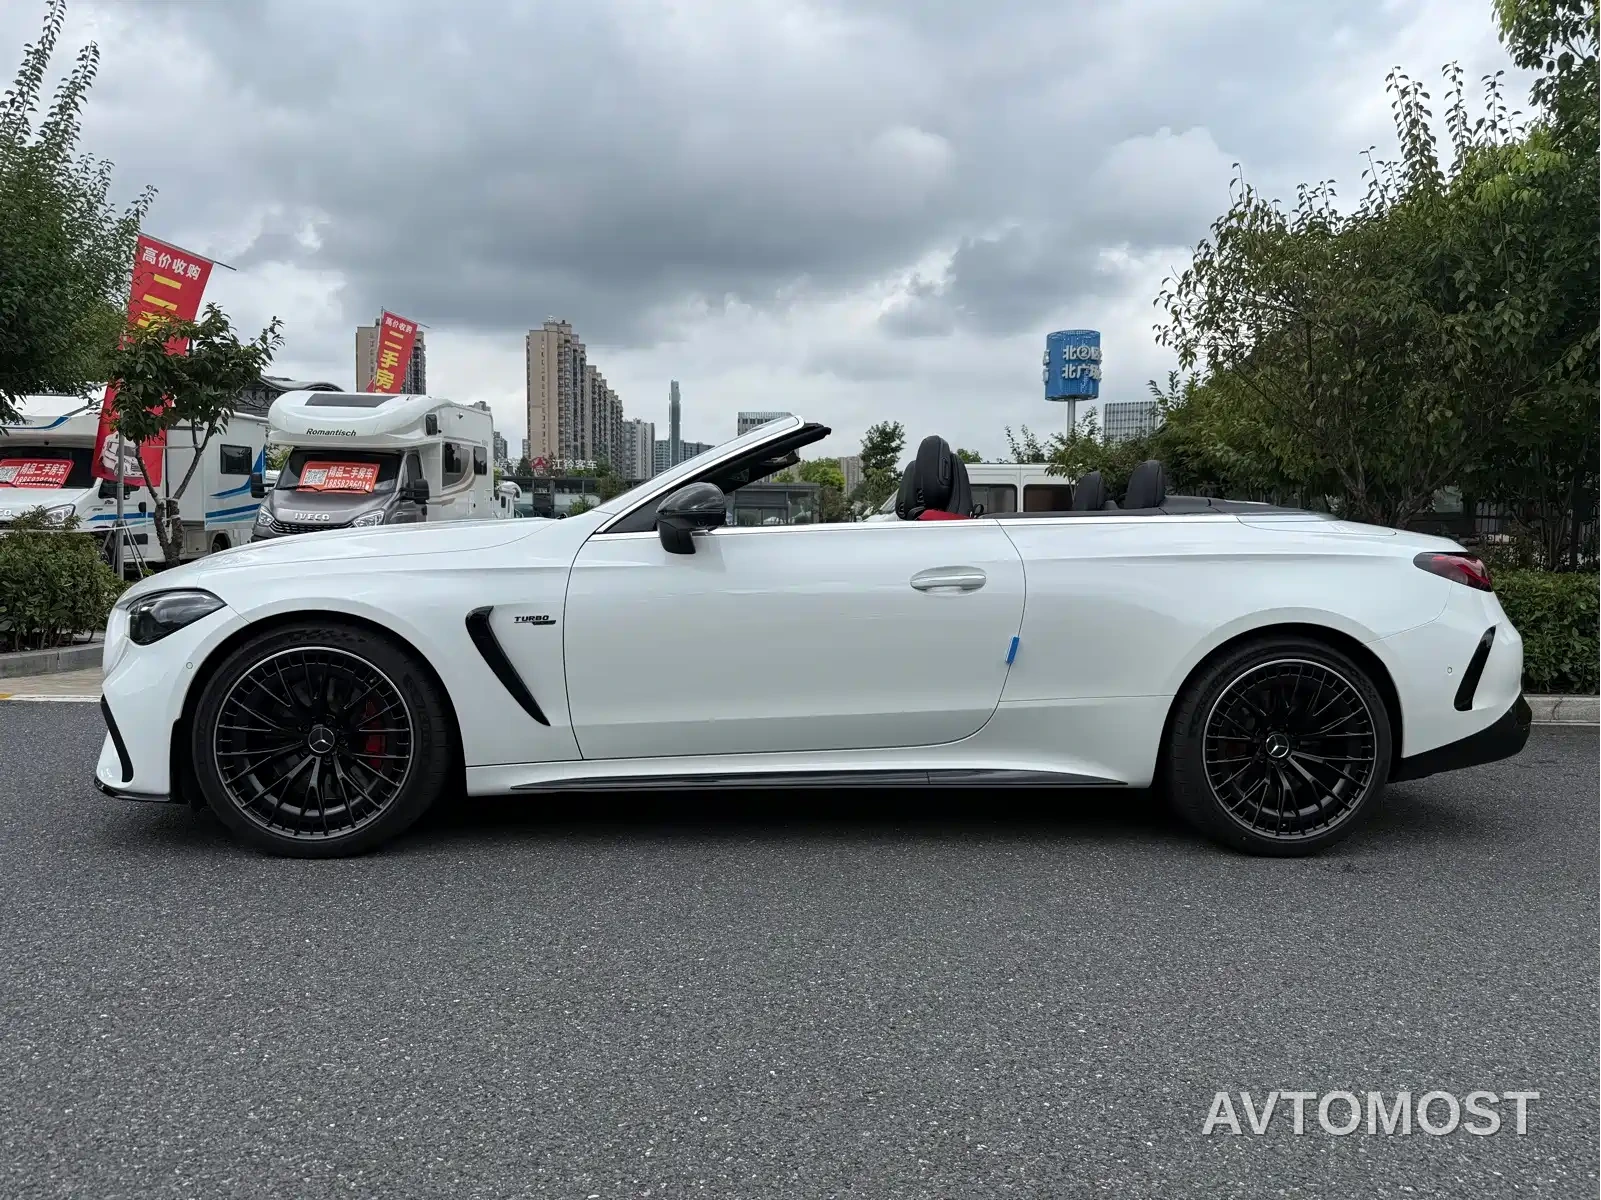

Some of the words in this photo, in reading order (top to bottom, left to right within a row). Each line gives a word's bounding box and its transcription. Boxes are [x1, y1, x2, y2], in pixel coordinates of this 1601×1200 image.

[142, 246, 201, 280] 高价收购
[385, 317, 413, 334] 高价收购
[375, 330, 404, 393] 二手房
[306, 428, 357, 437] Romantisch
[20, 463, 67, 476] 精品二手房车
[552, 459, 598, 471] 江铃客车
[328, 466, 375, 479] 精品二手房车
[294, 513, 330, 521] IVECO
